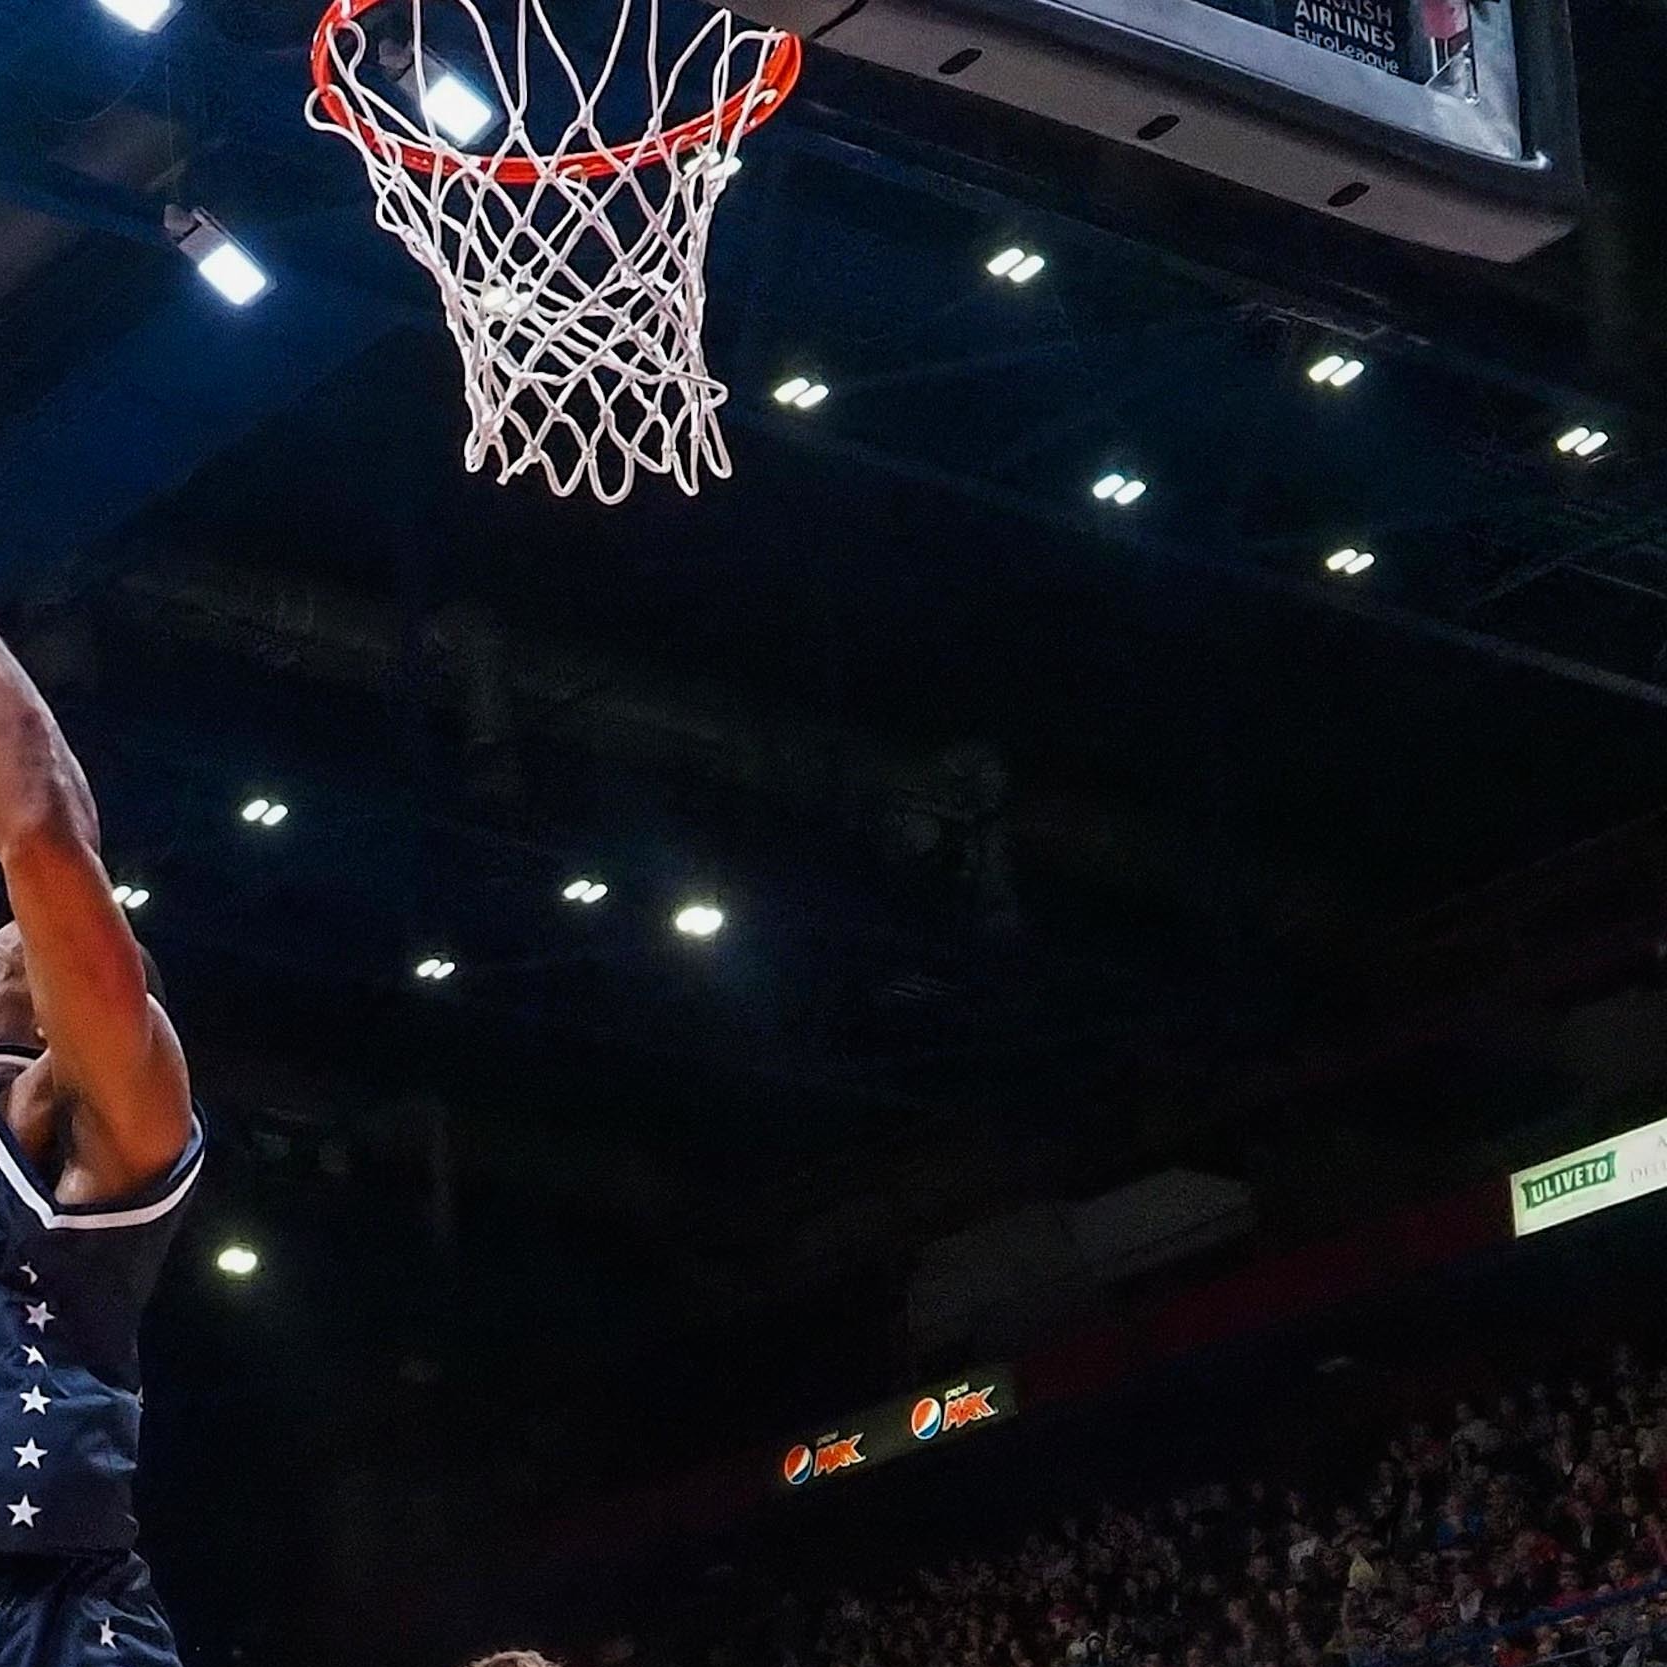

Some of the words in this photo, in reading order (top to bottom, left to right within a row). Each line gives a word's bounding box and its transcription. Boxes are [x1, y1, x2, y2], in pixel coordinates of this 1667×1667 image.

[1293, 0, 1397, 52] AIRLINES
[1326, 0, 1393, 28] KISH
[1530, 1160, 1609, 1203] ULIVETO
